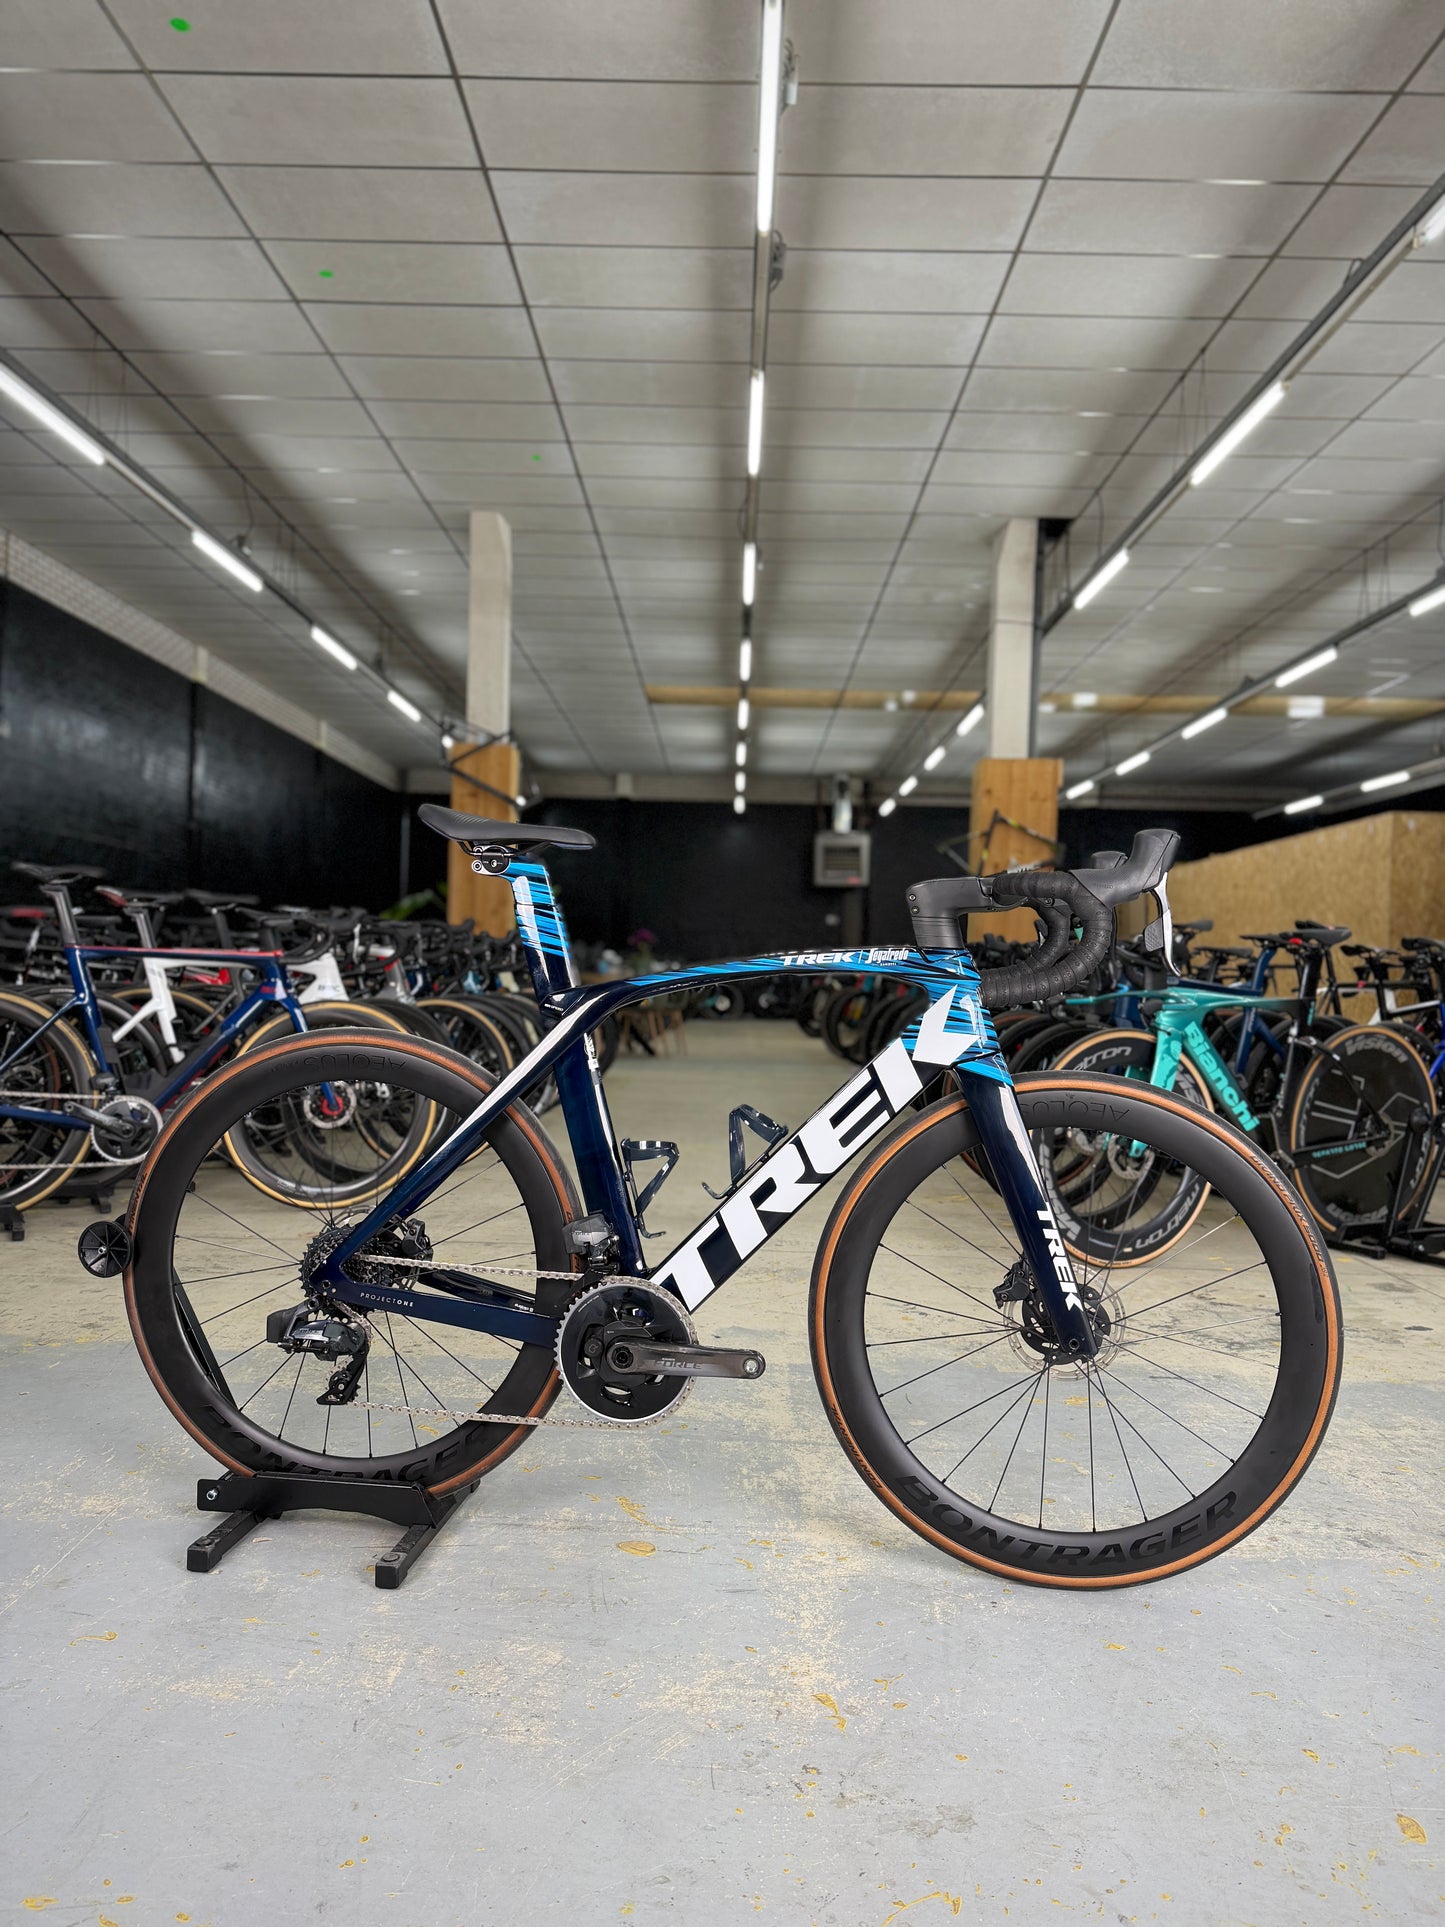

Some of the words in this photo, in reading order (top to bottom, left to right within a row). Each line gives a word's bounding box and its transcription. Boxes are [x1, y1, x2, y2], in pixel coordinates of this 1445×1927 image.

[780, 952, 857, 966] TREK
[865, 947, 909, 964] Segafredo
[303, 1053, 406, 1072] AEOLUS
[1072, 1045, 1132, 1072] etron
[1184, 1021, 1260, 1132] Bianchi
[1345, 1035, 1408, 1064] Vision
[650, 984, 981, 1315] TREK
[129, 1172, 148, 1237] TINENTAL
[1135, 1181, 1200, 1248] metron
[1249, 1154, 1286, 1191] GRAND
[1284, 1191, 1307, 1222] PRIX
[1303, 1223, 1325, 1263] 5000
[1036, 1201, 1084, 1312] TREK
[832, 1403, 883, 1489] CONTINENTAL
[895, 1475, 1237, 1567] BONTRAGER
